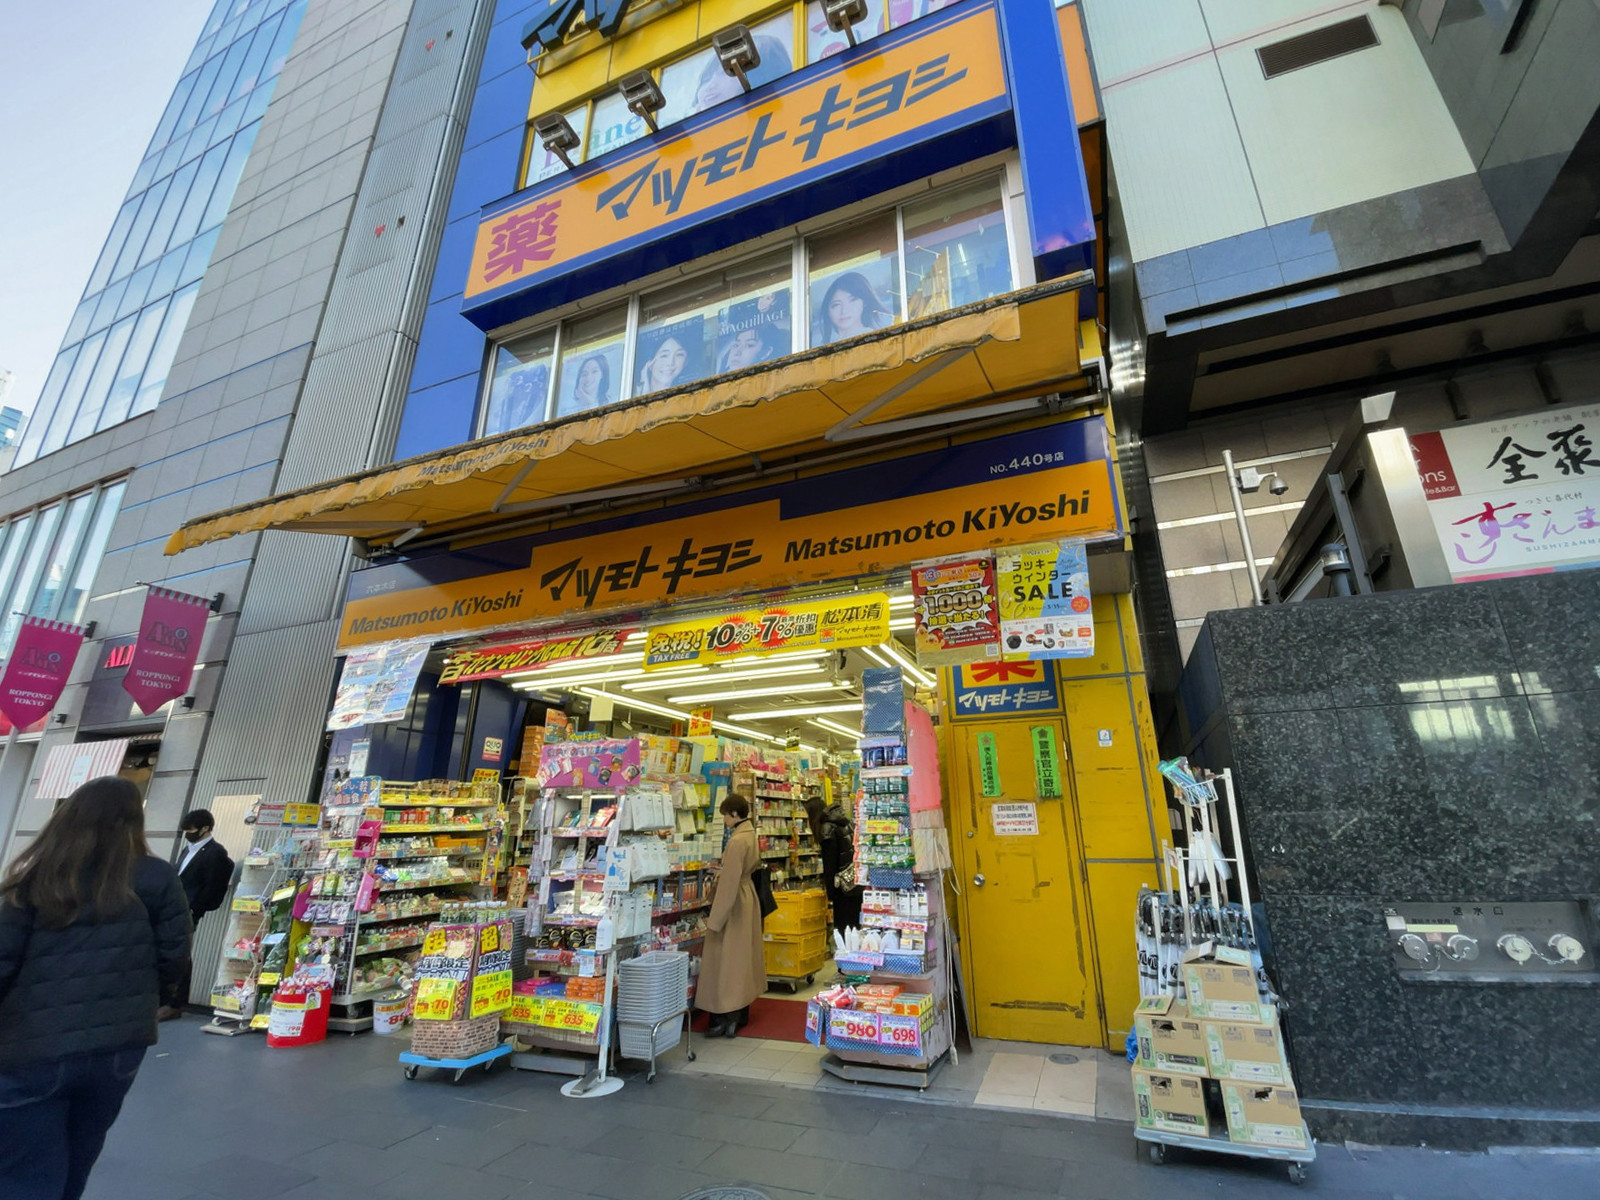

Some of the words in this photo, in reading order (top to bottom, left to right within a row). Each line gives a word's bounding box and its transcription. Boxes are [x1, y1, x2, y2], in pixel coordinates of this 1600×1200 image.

[484, 199, 563, 285] 薬
[596, 53, 969, 221] マツモトキヨシ
[784, 519, 956, 564] Matsumoto
[962, 489, 1091, 535] KiYoshi
[540, 538, 763, 607] マツモトキヨシ
[1012, 558, 1057, 572] ラッキー
[1013, 581, 1074, 603] SALE
[348, 606, 448, 636] Matsumoto
[450, 588, 525, 619] KiYoshi
[821, 602, 883, 625] 松本清
[653, 654, 669, 663] TAX
[670, 652, 690, 661] FREE
[136, 669, 181, 682] ROPPONGI
[141, 679, 172, 690] TOKYO
[9, 689, 53, 700] ROPPONGI
[14, 697, 45, 707] TOKYO
[958, 687, 1054, 711] マツモトキヨシ
[512, 1007, 531, 1019] 635
[564, 1013, 584, 1026] 635
[846, 1021, 877, 1038] 980
[892, 1027, 916, 1043] 698
